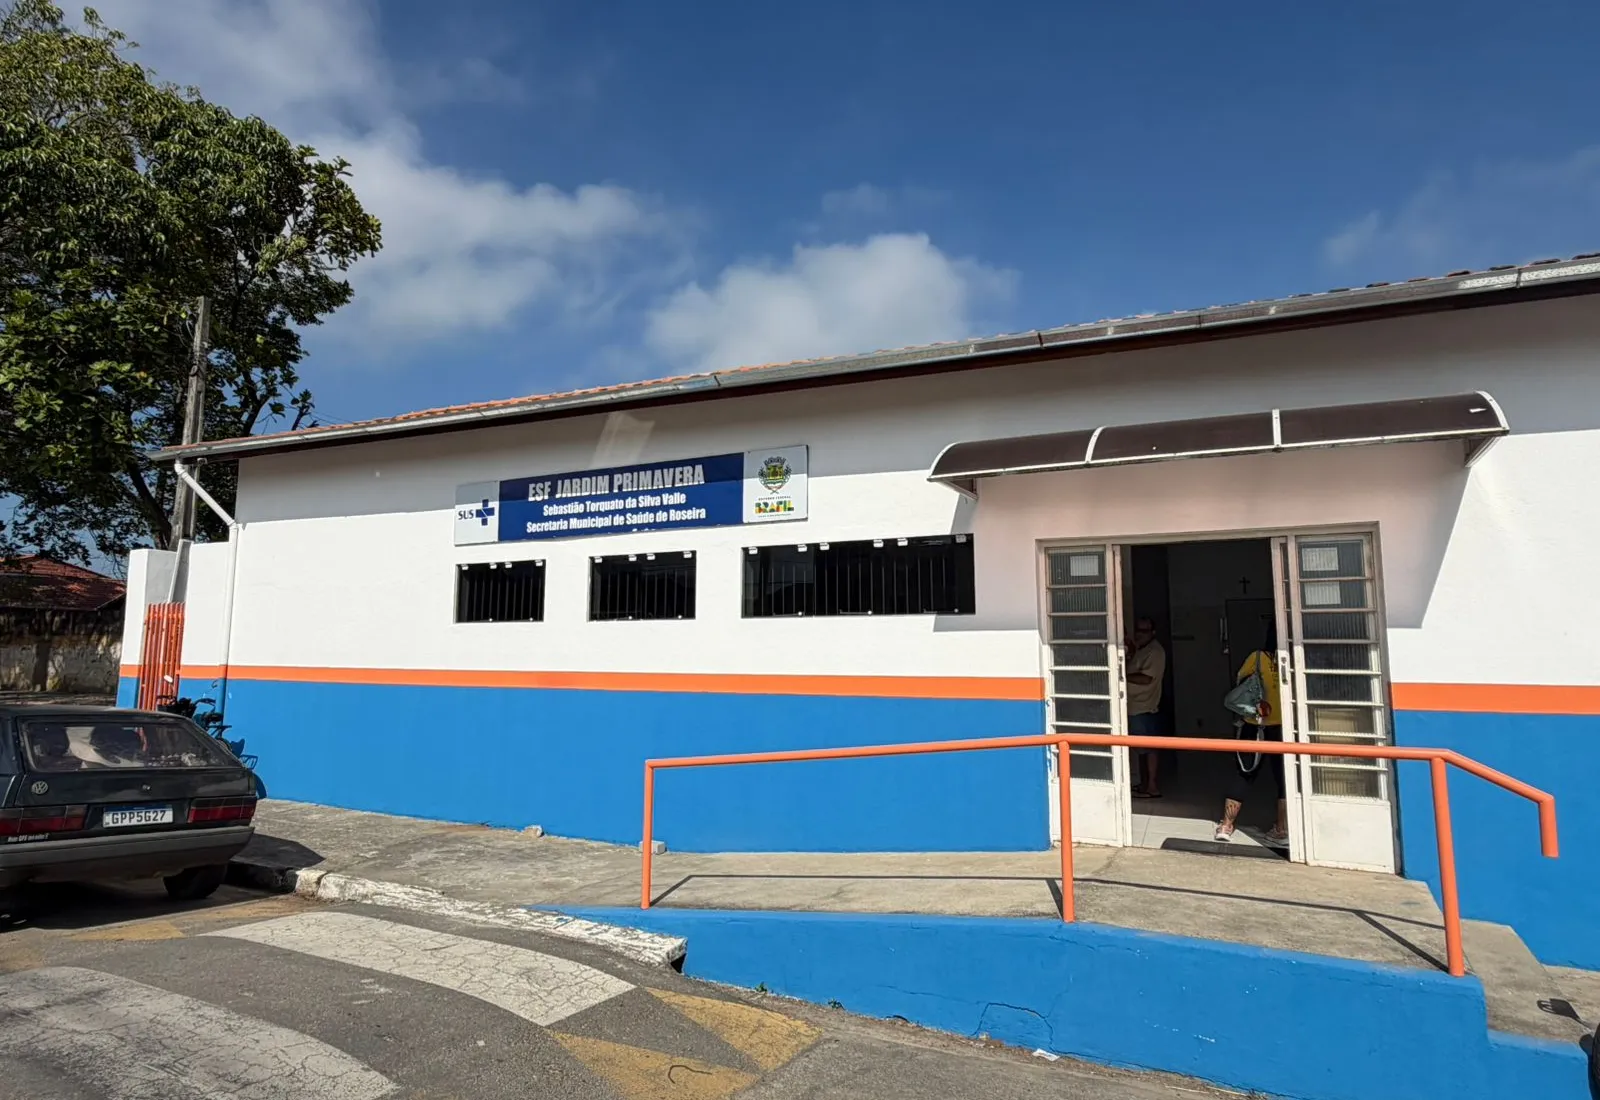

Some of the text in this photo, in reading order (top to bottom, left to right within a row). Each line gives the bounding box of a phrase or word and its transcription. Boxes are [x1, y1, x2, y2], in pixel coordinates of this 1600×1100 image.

[528, 464, 705, 502] ESF JARDIM PRIMAVERA
[458, 509, 474, 520] SUS
[543, 492, 686, 517] Sebastião Torquato da Silva Valle
[526, 507, 706, 534] Secretaria Municipal de Saúde de Roseira
[111, 810, 167, 825] GPP5G27
